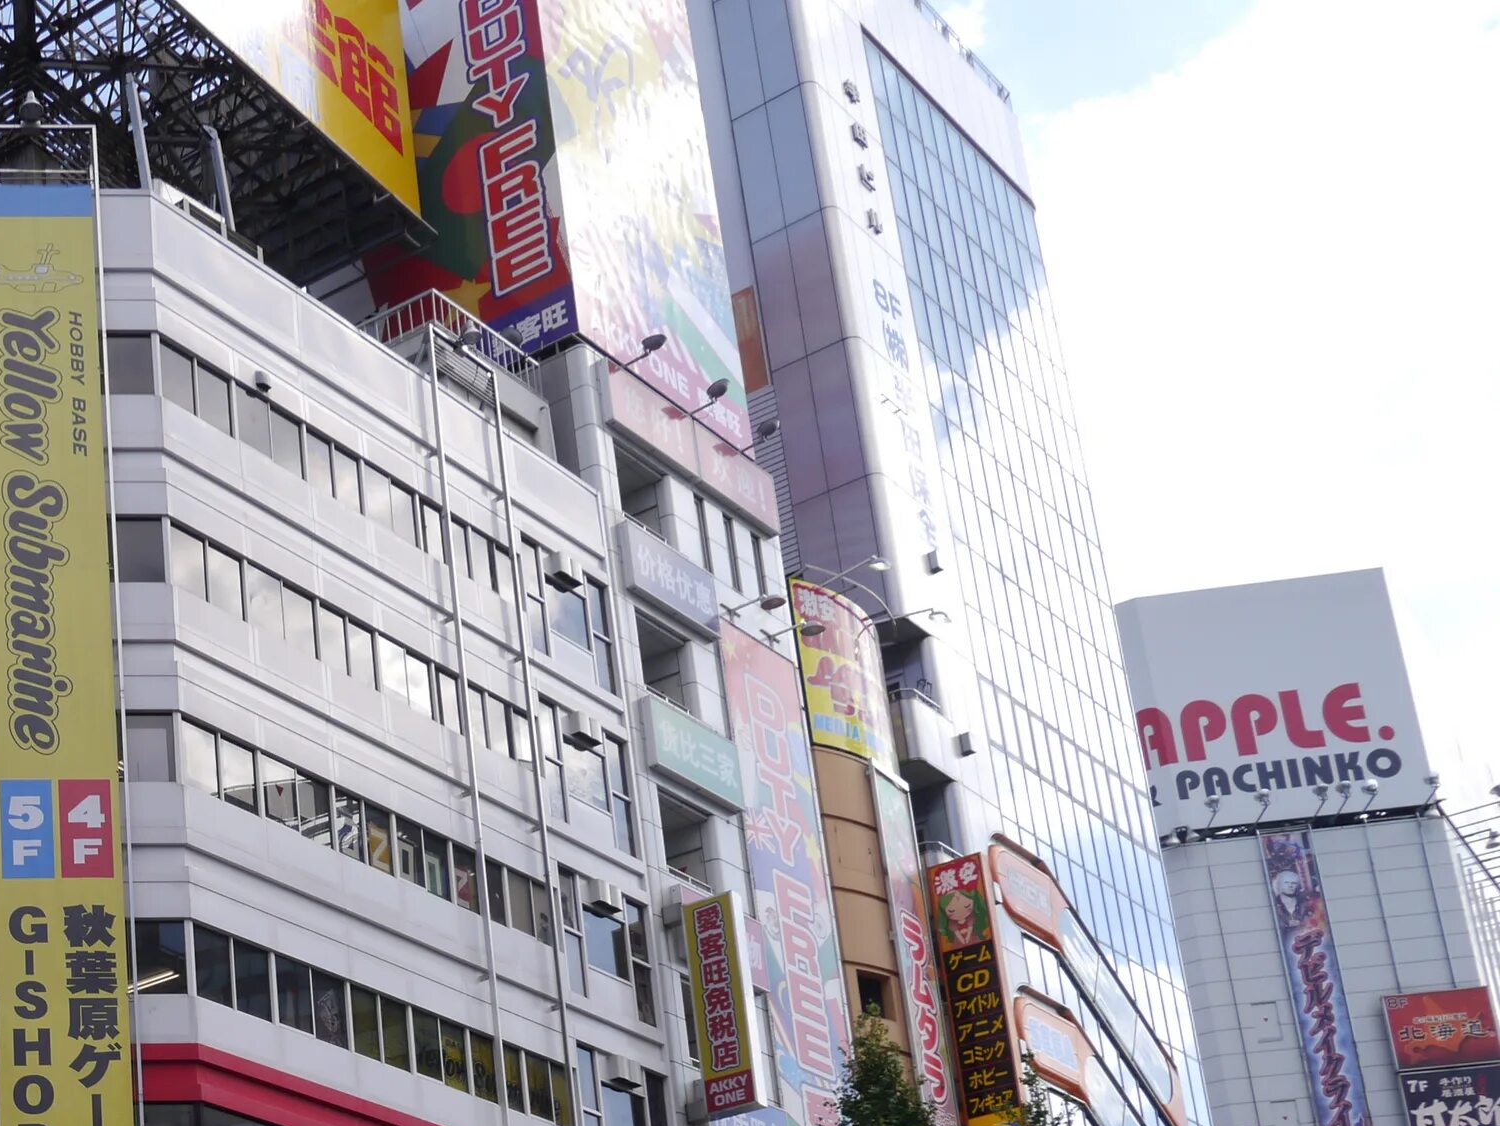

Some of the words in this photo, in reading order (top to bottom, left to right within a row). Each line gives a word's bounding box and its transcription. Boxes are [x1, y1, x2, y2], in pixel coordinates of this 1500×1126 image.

[480, 118, 553, 297] FREE
[69, 310, 86, 387] HOBBY
[648, 350, 691, 400] ONE
[71, 396, 89, 456] BASE
[636, 543, 715, 617] 价格优惠
[1, 467, 74, 756] Submarine
[743, 672, 801, 867] DUTY
[1176, 748, 1403, 800] PACHINKO
[947, 946, 993, 973] ゲーム
[771, 868, 839, 1083] FREE
[956, 969, 990, 993] CD
[954, 993, 1000, 1020] アイドル
[957, 1015, 1004, 1043] アニメ
[1399, 1019, 1489, 1041] 北海道
[962, 1042, 1006, 1066] コミック
[708, 1074, 749, 1097] AKKY
[967, 1066, 1008, 1092] ホビー
[1405, 1078, 1429, 1094] 7F
[714, 1088, 747, 1107] ONE
